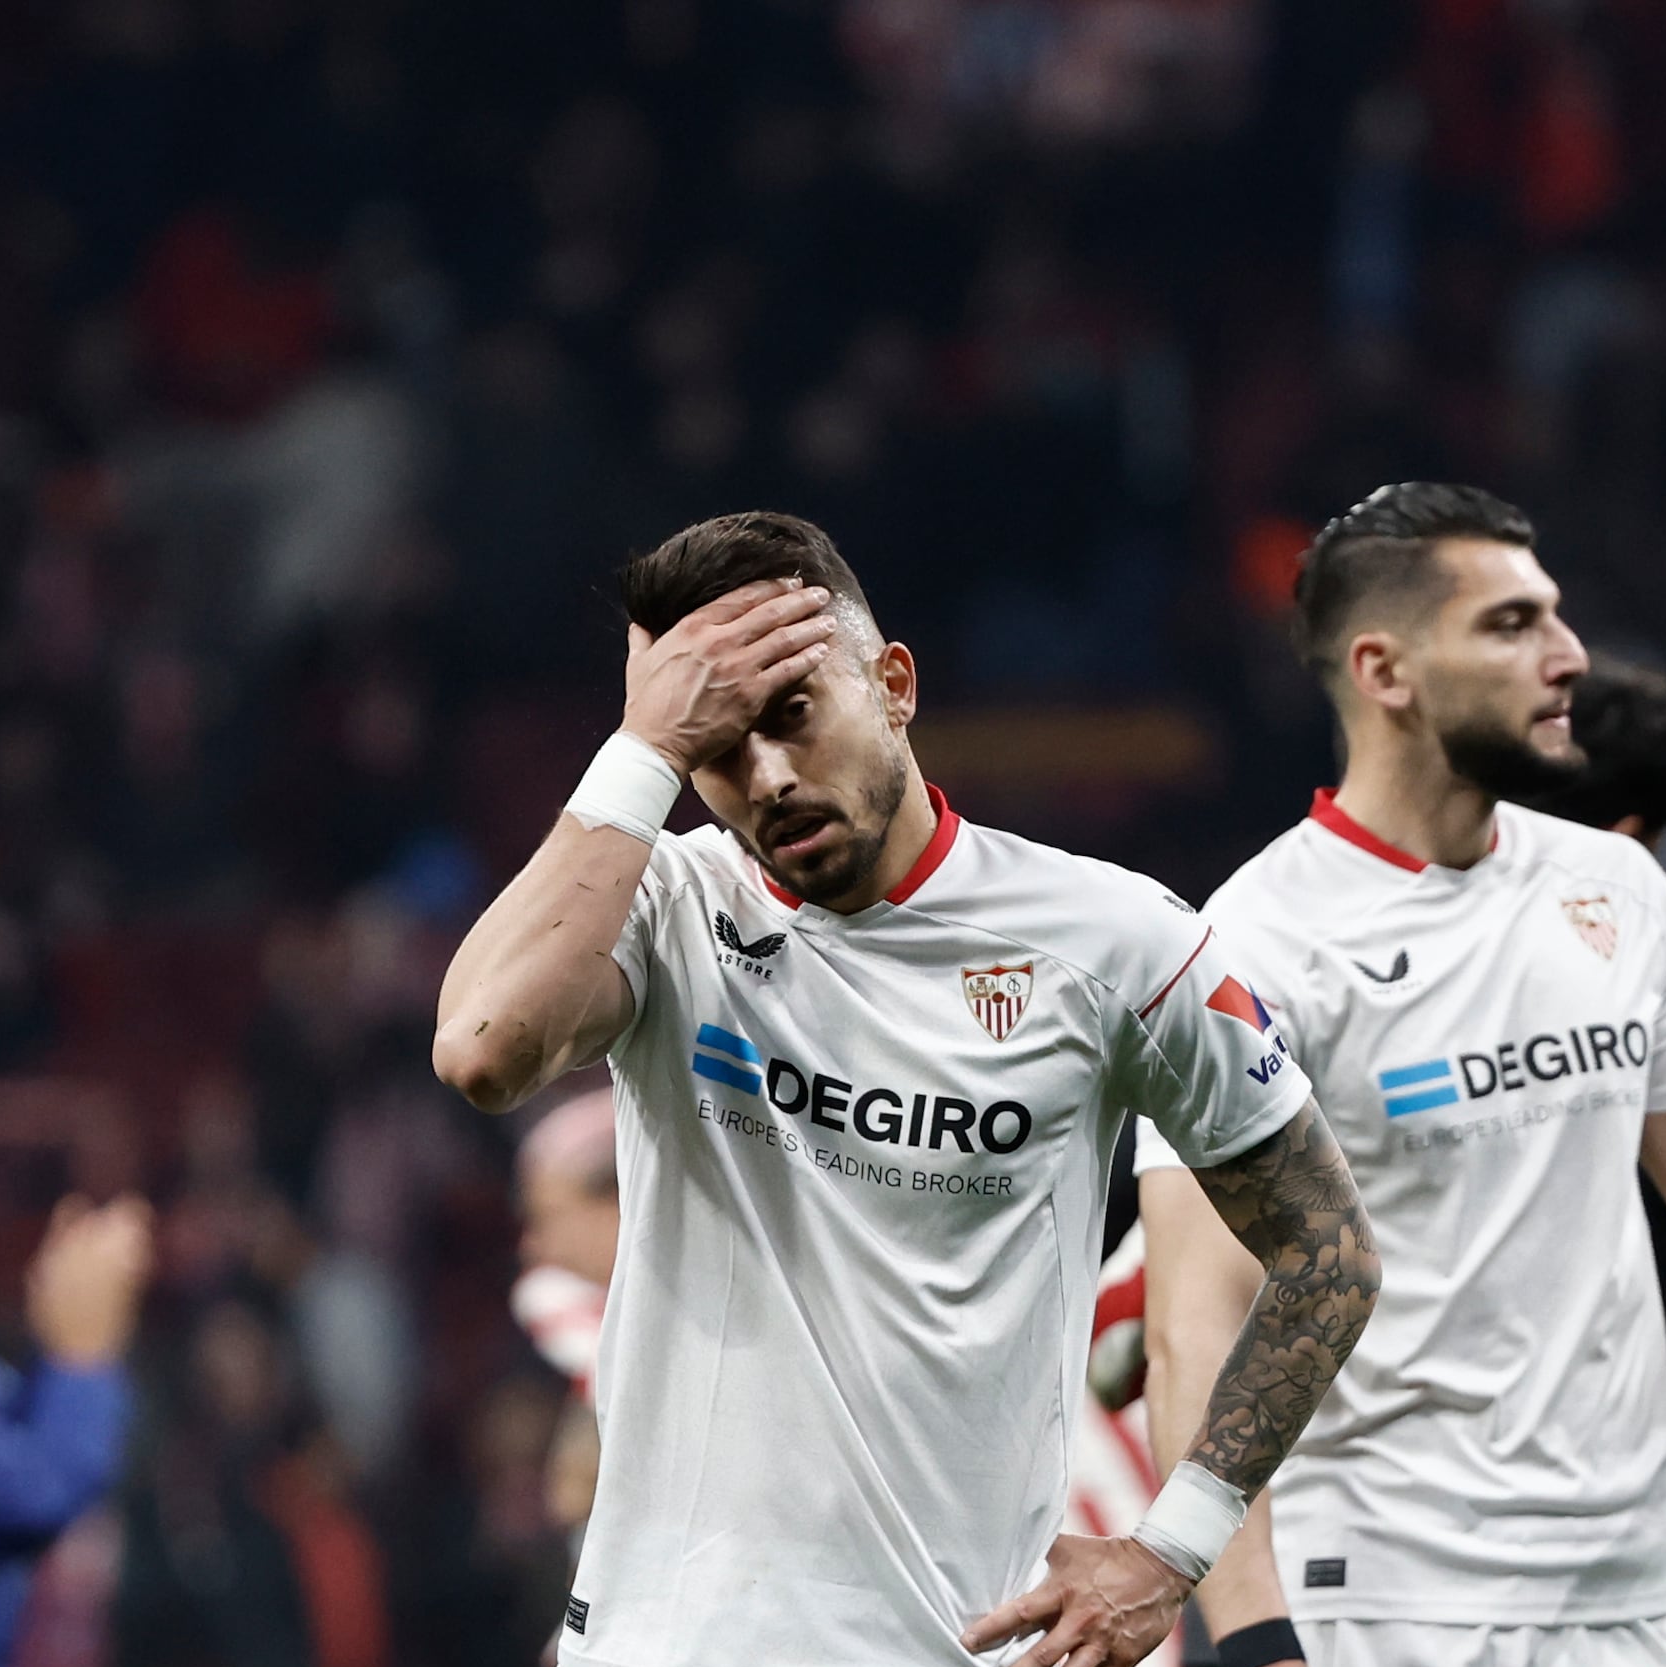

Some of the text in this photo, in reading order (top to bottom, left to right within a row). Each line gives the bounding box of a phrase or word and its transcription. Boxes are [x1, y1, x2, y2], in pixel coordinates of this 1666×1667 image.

[716, 953, 773, 980] ASTORE
[1460, 1020, 1648, 1099] DEGIRO
[698, 1099, 1013, 1195] EUROPE'S LEADING BROKER
[766, 1057, 1033, 1154] DEGIRO
